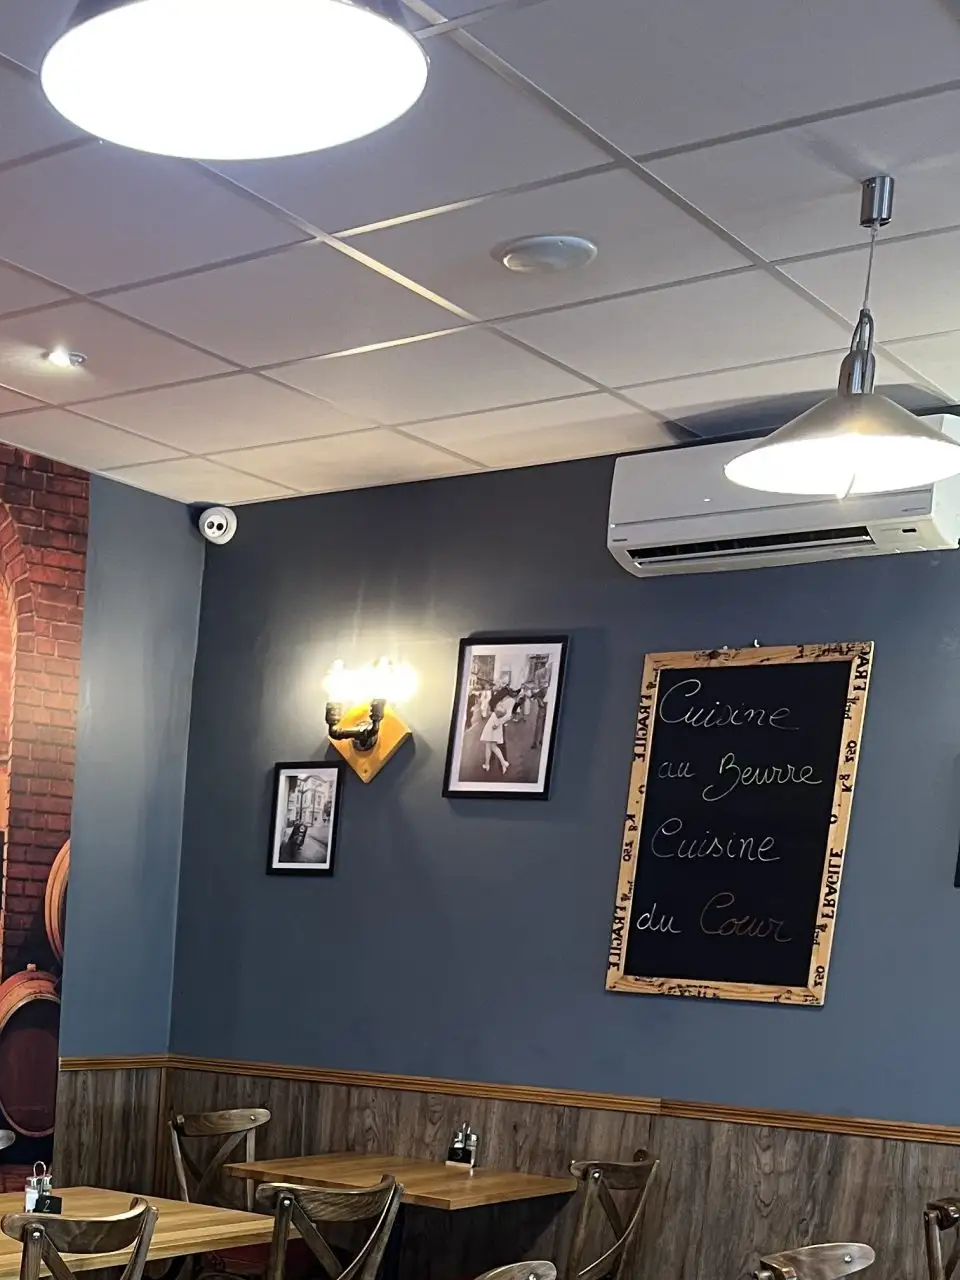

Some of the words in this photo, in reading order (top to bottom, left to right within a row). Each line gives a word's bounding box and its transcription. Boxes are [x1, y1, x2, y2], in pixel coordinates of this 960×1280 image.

[659, 679, 800, 730] Cuisine
[657, 761, 697, 779] au
[702, 752, 823, 802] Beurre
[651, 817, 781, 862] Cuisine
[636, 902, 682, 934] du
[42, 1199, 51, 1212] 2
